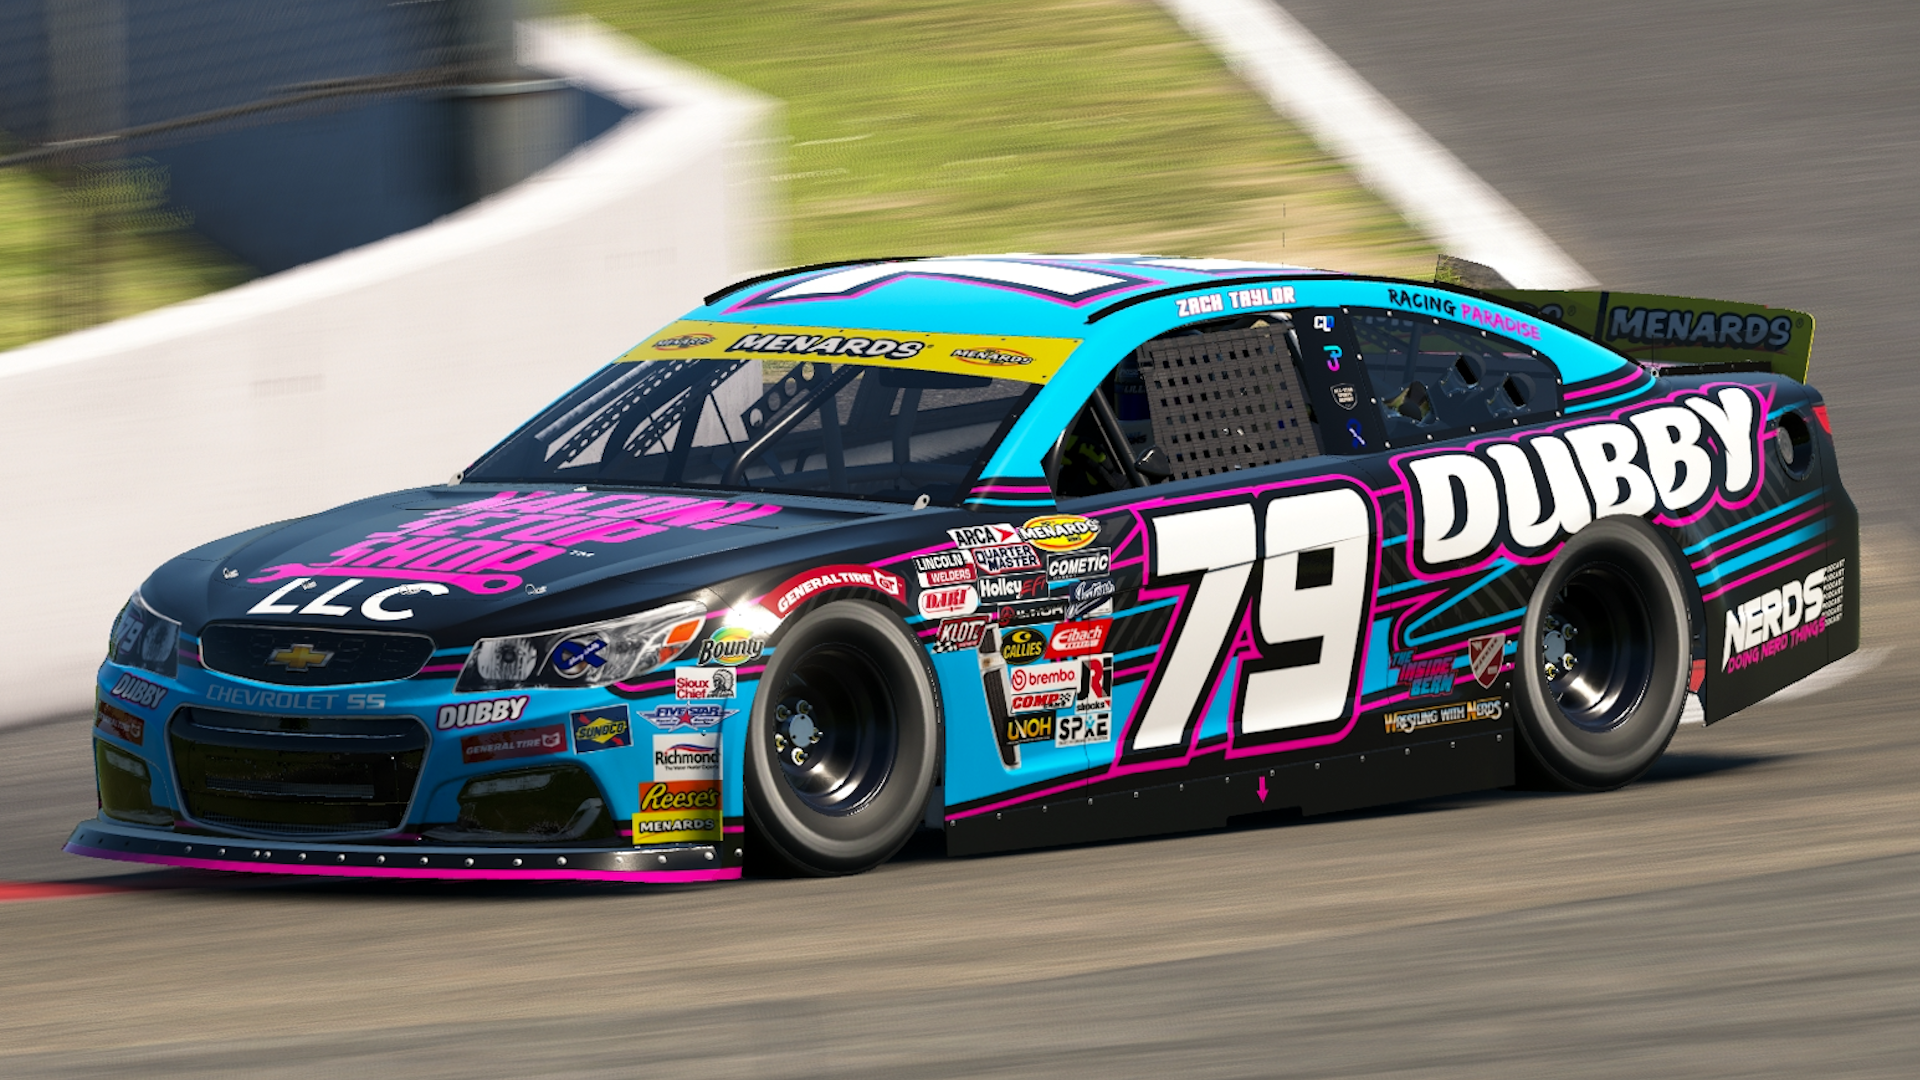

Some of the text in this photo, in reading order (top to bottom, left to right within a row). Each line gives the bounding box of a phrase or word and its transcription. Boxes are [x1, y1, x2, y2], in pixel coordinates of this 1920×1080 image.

[1175, 285, 1296, 317] ZACH TAYLOR
[1387, 287, 1458, 317] RACING
[1460, 303, 1543, 341] PARADISE
[1609, 305, 1793, 349] MENARDS
[724, 332, 926, 360] MENARDS
[949, 348, 1034, 365] MENARDS
[1409, 387, 1755, 565] DUBBY
[954, 526, 997, 546] ARCA
[1019, 518, 1100, 542] MENARDS
[310, 536, 568, 573] SHOP
[915, 552, 963, 571] LINCOLN
[973, 545, 1031, 566] QUARTER
[988, 555, 1039, 572] MASTER
[1049, 554, 1109, 576] COMETIC
[931, 568, 971, 583] WELDERS
[979, 575, 1023, 599] Holley
[246, 577, 450, 621] LLC
[777, 572, 874, 613] GENERAL TIRE
[1132, 488, 1370, 751] 79
[1721, 567, 1826, 673] NERDS
[1002, 641, 1042, 659] CALLIES
[1051, 625, 1103, 651] Eibach
[1727, 615, 1826, 674] DOING NERD THINGS
[698, 638, 764, 666] Bounty
[1392, 650, 1414, 667] THE
[1029, 668, 1075, 686] brembo
[1399, 656, 1454, 680] INSIDE
[110, 673, 169, 710] DUBBY
[676, 677, 709, 689] Sioux
[676, 688, 707, 699] Chief
[205, 683, 386, 711] CHEVROLET SS
[1012, 693, 1060, 709] COMP
[1076, 700, 1105, 712] shocks
[437, 696, 528, 730] DUBBY
[1440, 705, 1465, 722] WITH
[576, 721, 626, 740] SUNOCO
[1006, 716, 1052, 741] UNOH
[466, 738, 541, 755] GENERAL TIRE
[655, 748, 720, 766] Richmond
[640, 782, 719, 811] Reese's
[639, 819, 715, 834] MENARDS
